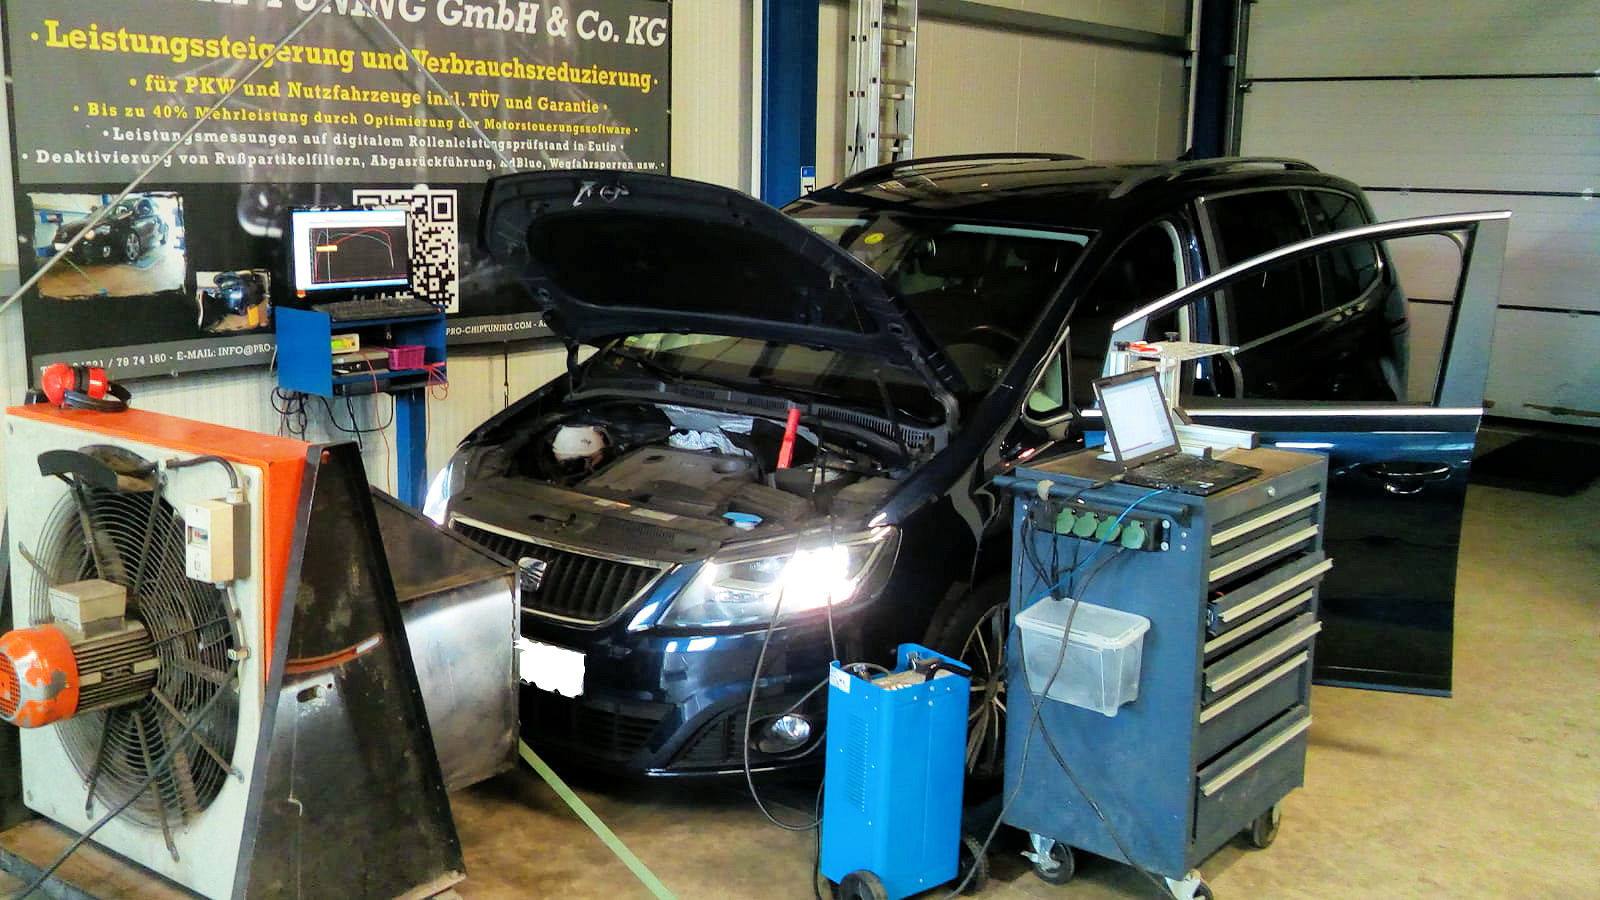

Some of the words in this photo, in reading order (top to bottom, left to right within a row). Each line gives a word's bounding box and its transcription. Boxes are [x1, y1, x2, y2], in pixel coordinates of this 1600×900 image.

[436, 0, 538, 34] GmbH
[546, 7, 569, 37] &
[576, 10, 620, 42] Co.
[626, 16, 667, 47] KG
[44, 19, 354, 72] Leistungssteigerung
[361, 50, 408, 71] und
[411, 49, 651, 93] Verbrauchsreduzierung
[145, 74, 178, 93] für
[184, 76, 236, 96] PKW
[244, 77, 280, 98] und
[288, 81, 421, 108] Nutzfahrzeuge
[468, 90, 500, 109] TÜV
[504, 96, 532, 111] und
[537, 96, 599, 114] Garantie
[88, 102, 117, 117] Bis
[124, 107, 145, 118] zu
[153, 104, 188, 119] 40%
[195, 106, 308, 125] Mehrleistung
[313, 110, 358, 126] durch
[363, 113, 453, 129] Optimierung
[484, 119, 631, 136] Motorsteuerungssoftware
[112, 128, 298, 147] Leistungsmessungen
[303, 132, 327, 146] auf
[333, 133, 404, 148] digitalem
[574, 140, 584, 150] in
[588, 141, 616, 152] Eutin
[36, 150, 172, 168] Deaktivierung
[179, 154, 209, 165] von
[370, 155, 496, 170] Abgasrückführung,
[117, 358, 130, 367] 79
[133, 356, 145, 366] 74
[149, 354, 167, 364] 160
[176, 348, 216, 361] E-MAIL:
